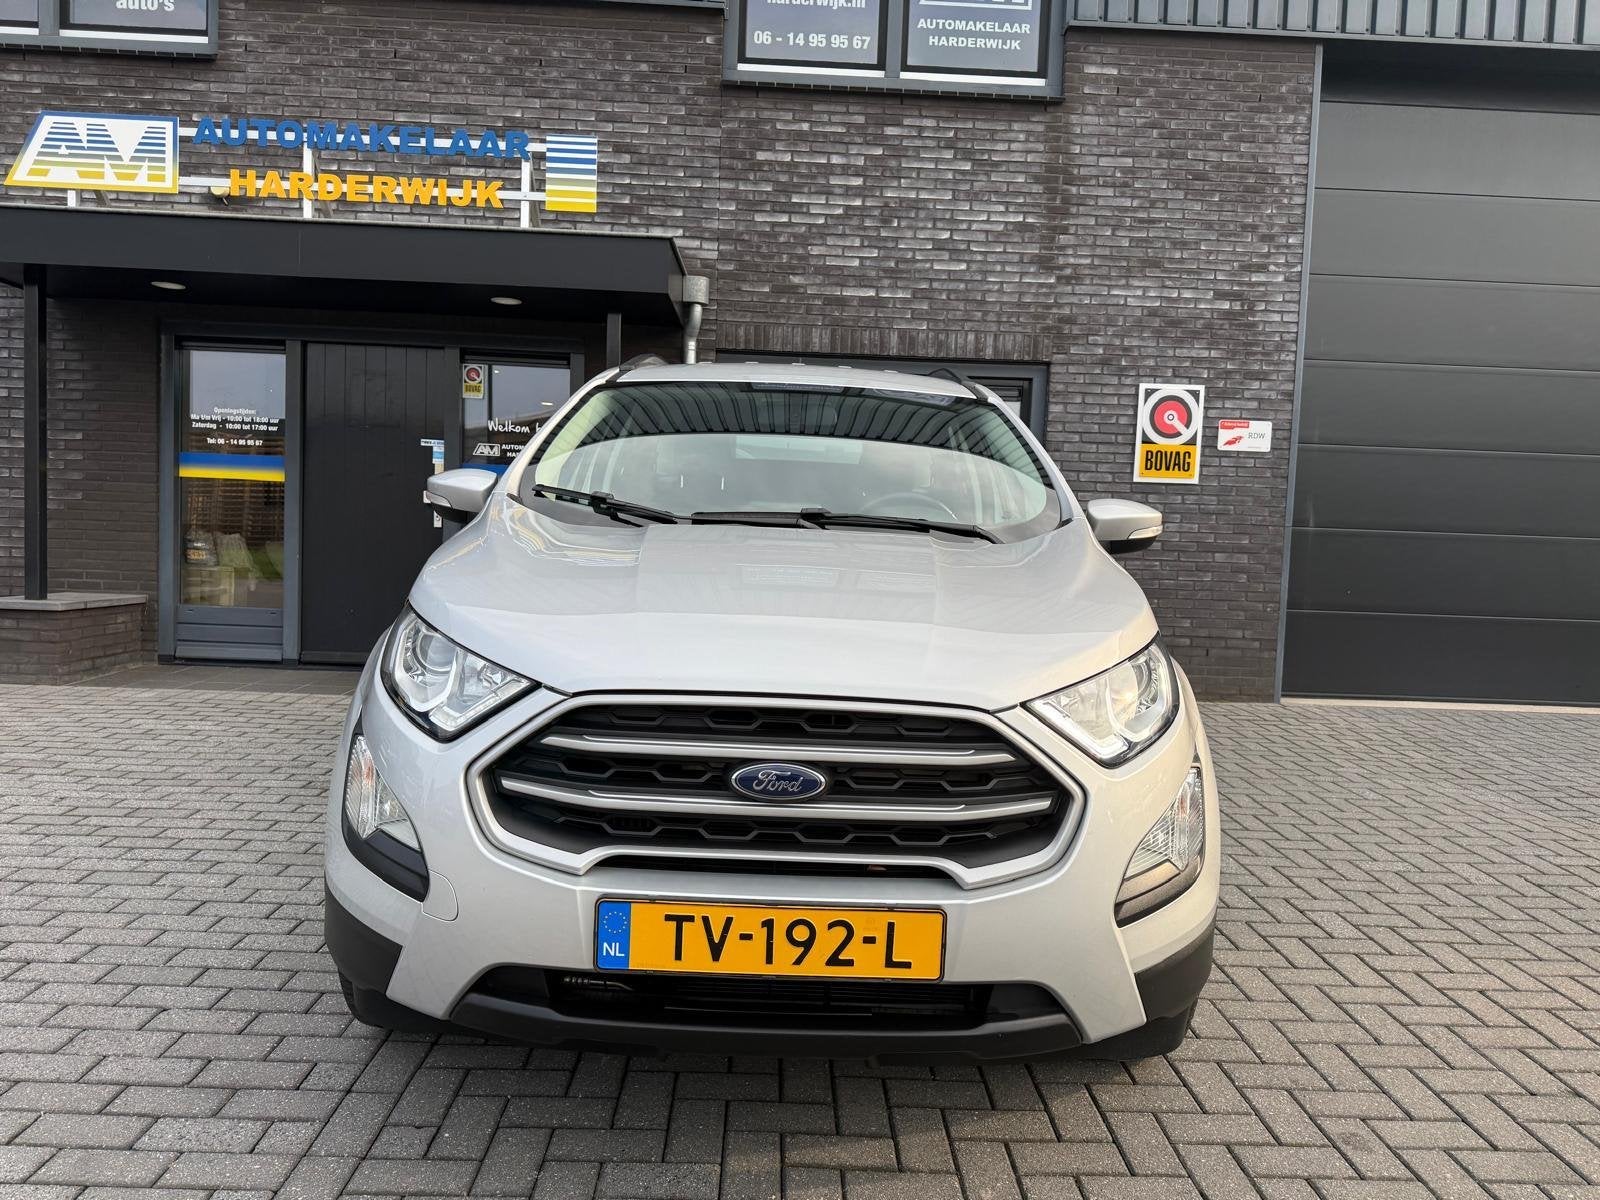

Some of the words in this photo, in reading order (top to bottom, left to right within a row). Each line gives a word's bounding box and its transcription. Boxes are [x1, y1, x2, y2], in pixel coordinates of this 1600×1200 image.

[766, 0, 865, 10] erwijk.nl
[917, 18, 1031, 34] AUTOMAKELAAR
[753, 30, 771, 44] 06
[787, 32, 805, 46] 14
[808, 33, 827, 48] 95
[831, 34, 849, 49] 95
[852, 35, 871, 50] 67
[928, 36, 1022, 50] HARDERWIJK
[193, 117, 531, 161] AUTOMAKELAAR
[26, 121, 167, 183] AM
[229, 168, 505, 209] HARDERWIJK
[213, 407, 257, 415] Openingstijden:
[192, 422, 217, 430] Zaterdag
[487, 417, 530, 433] Welkom
[1248, 432, 1266, 440] RDW
[476, 445, 499, 455] AM
[1145, 450, 1192, 472] BOVAG
[752, 769, 803, 793] Ford
[602, 942, 625, 957] NL
[664, 913, 912, 970] TV-192-L
